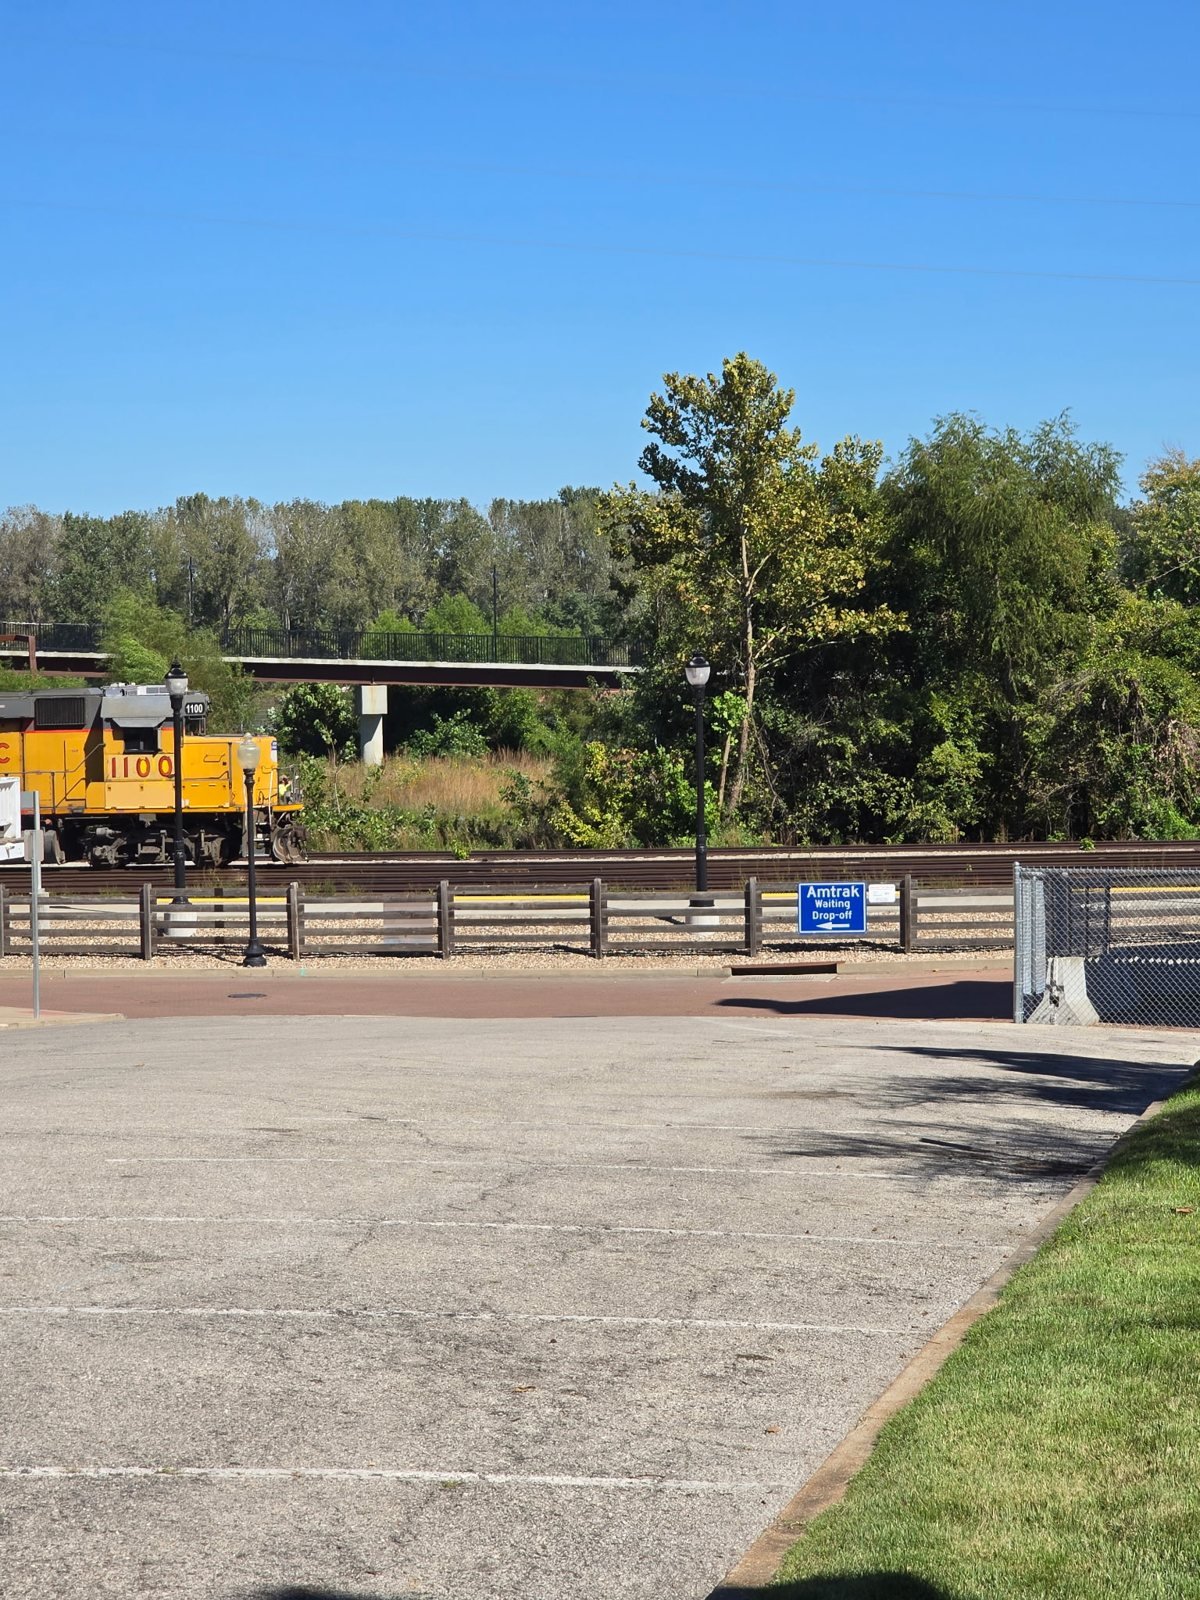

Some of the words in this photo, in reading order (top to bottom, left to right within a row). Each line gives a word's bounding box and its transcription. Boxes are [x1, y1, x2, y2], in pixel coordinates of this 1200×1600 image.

[186, 704, 203, 713] 1100
[112, 756, 173, 778] 1100
[807, 885, 860, 898] Amtrak
[815, 899, 850, 909] Waiting
[812, 911, 852, 921] Drop-off
